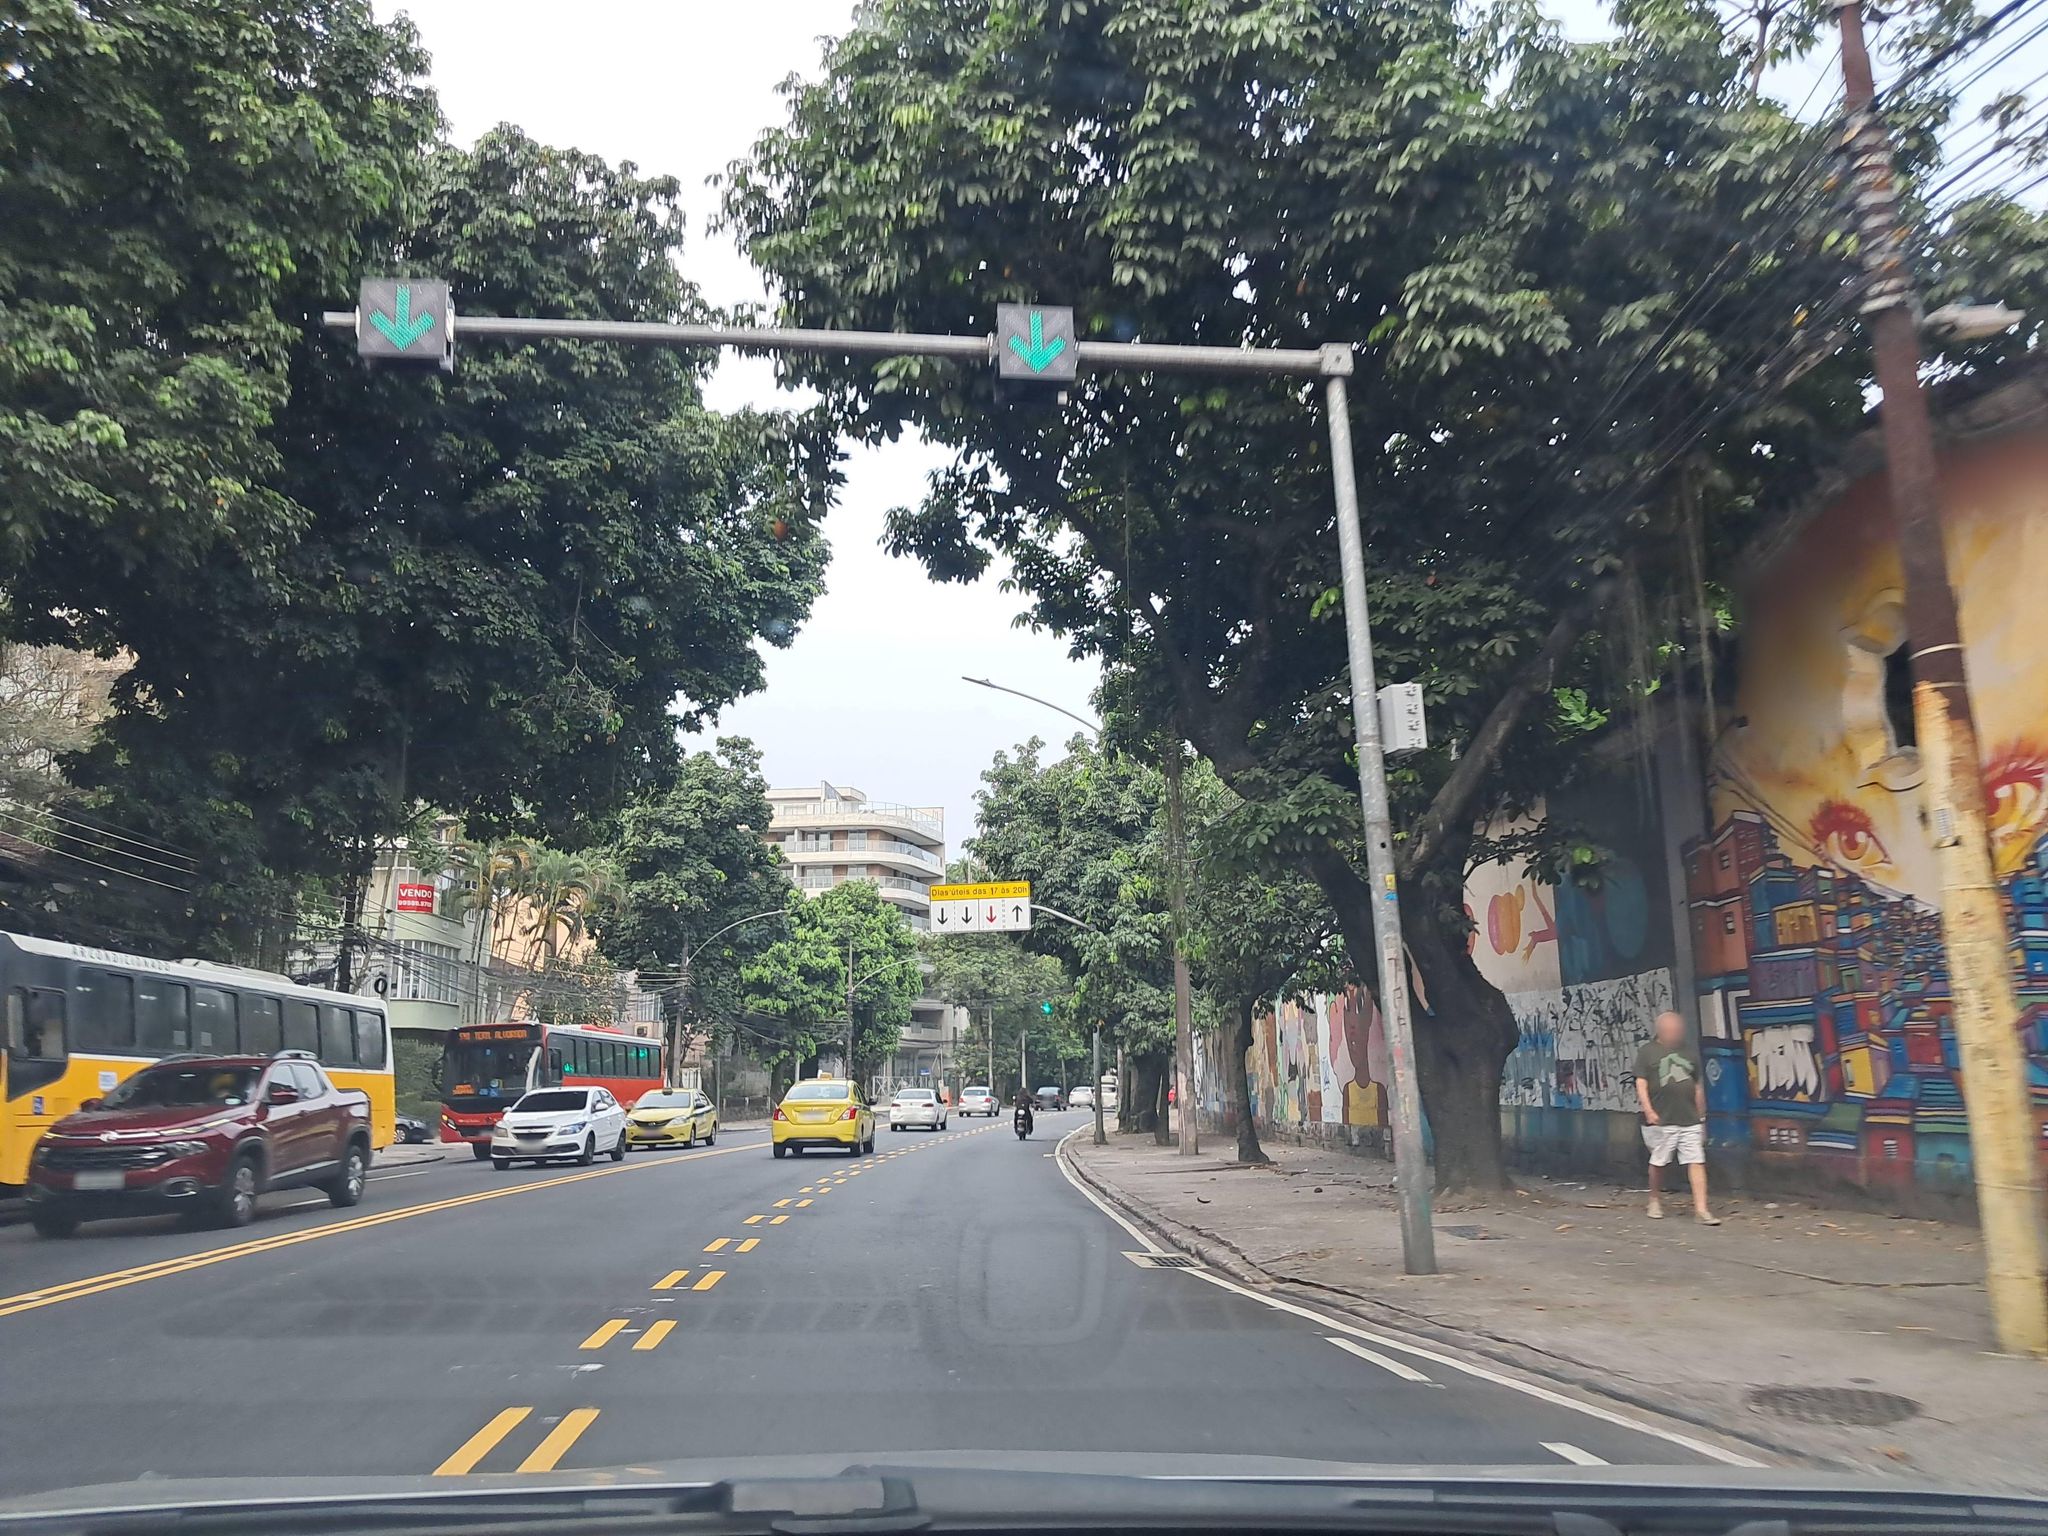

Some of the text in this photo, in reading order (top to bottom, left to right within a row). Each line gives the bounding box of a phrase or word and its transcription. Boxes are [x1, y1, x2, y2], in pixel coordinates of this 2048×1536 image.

[400, 889, 432, 899] VENDO
[931, 889, 949, 897] Dias
[951, 888, 970, 896] úteis
[990, 887, 998, 895] 17
